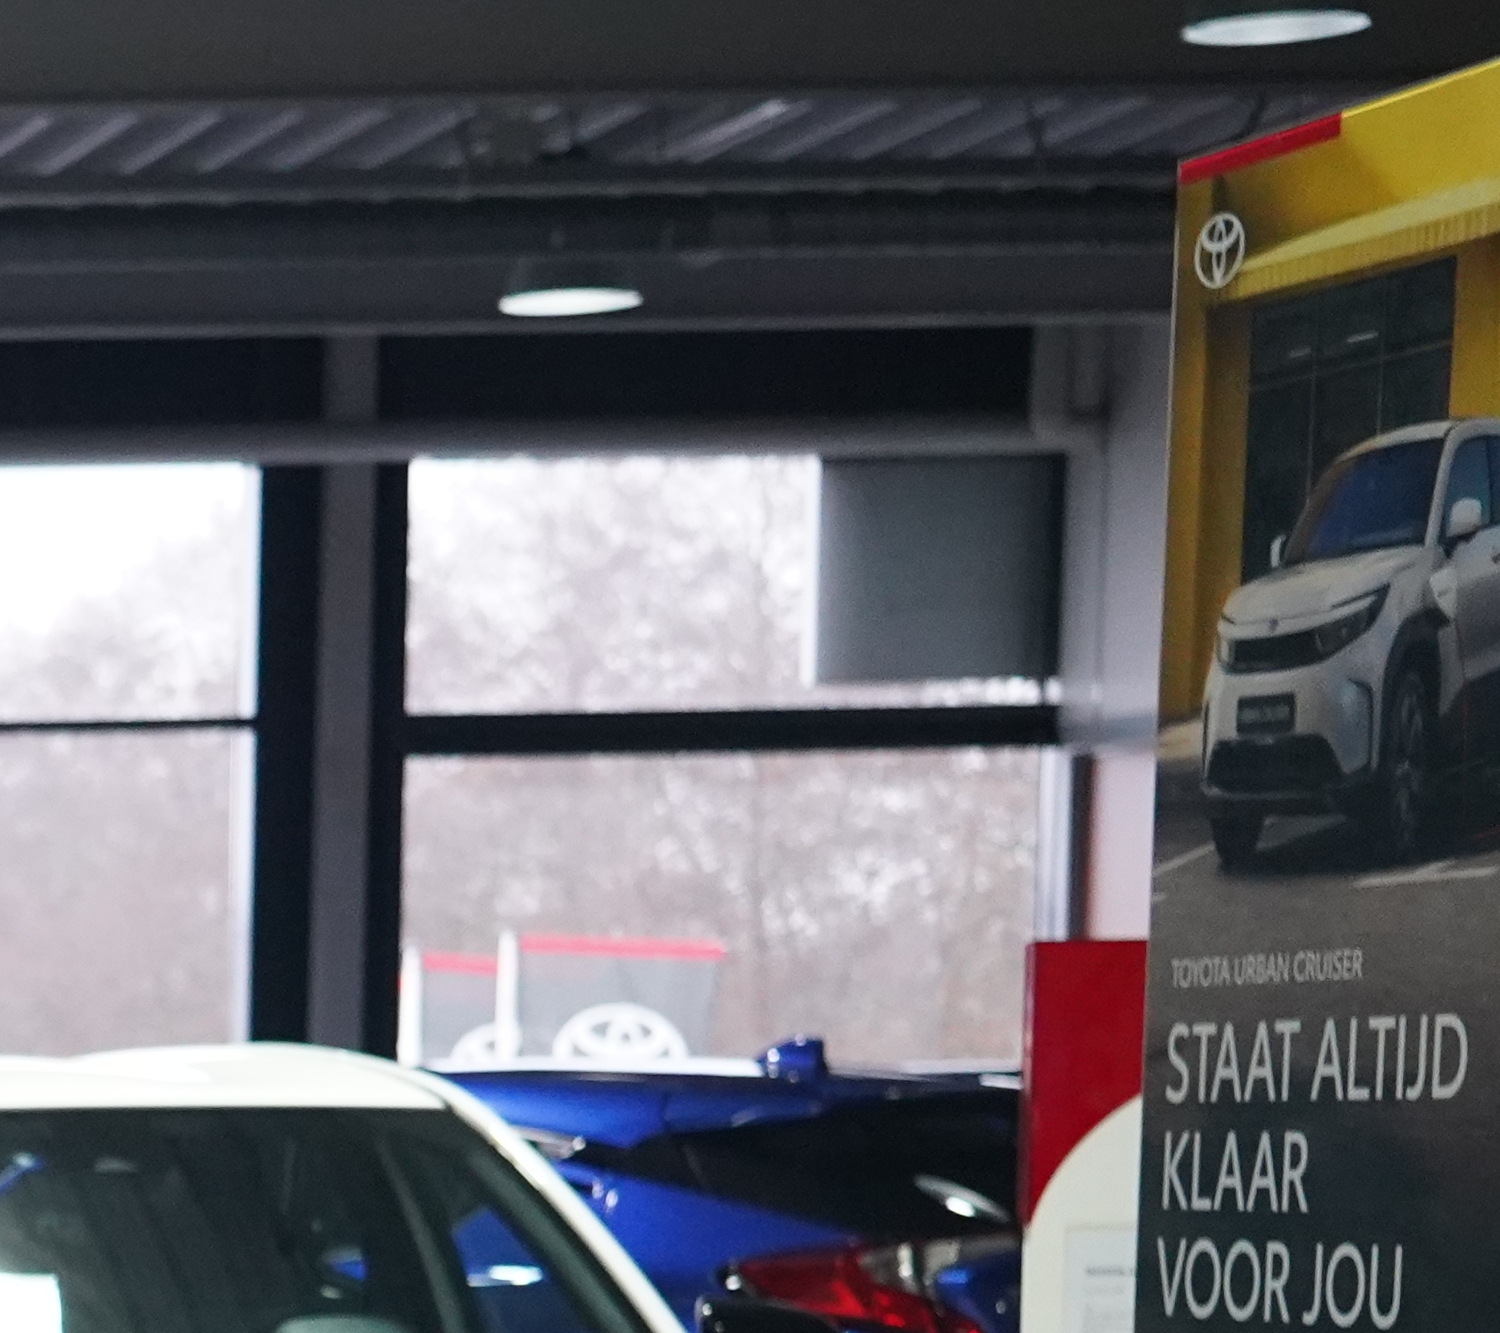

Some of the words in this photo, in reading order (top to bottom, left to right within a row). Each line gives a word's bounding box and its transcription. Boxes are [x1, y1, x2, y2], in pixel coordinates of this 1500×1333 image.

[1171, 955, 1231, 988] TOYOTA
[1233, 951, 1290, 986] URBAN
[1293, 947, 1364, 984] CRUISER
[1165, 1019, 1302, 1104] STAAT
[1311, 1012, 1469, 1102] ALTIJD
[1162, 1129, 1309, 1214] KLAAR
[1157, 1236, 1290, 1324] VOOR
[1303, 1242, 1403, 1330] JOU
